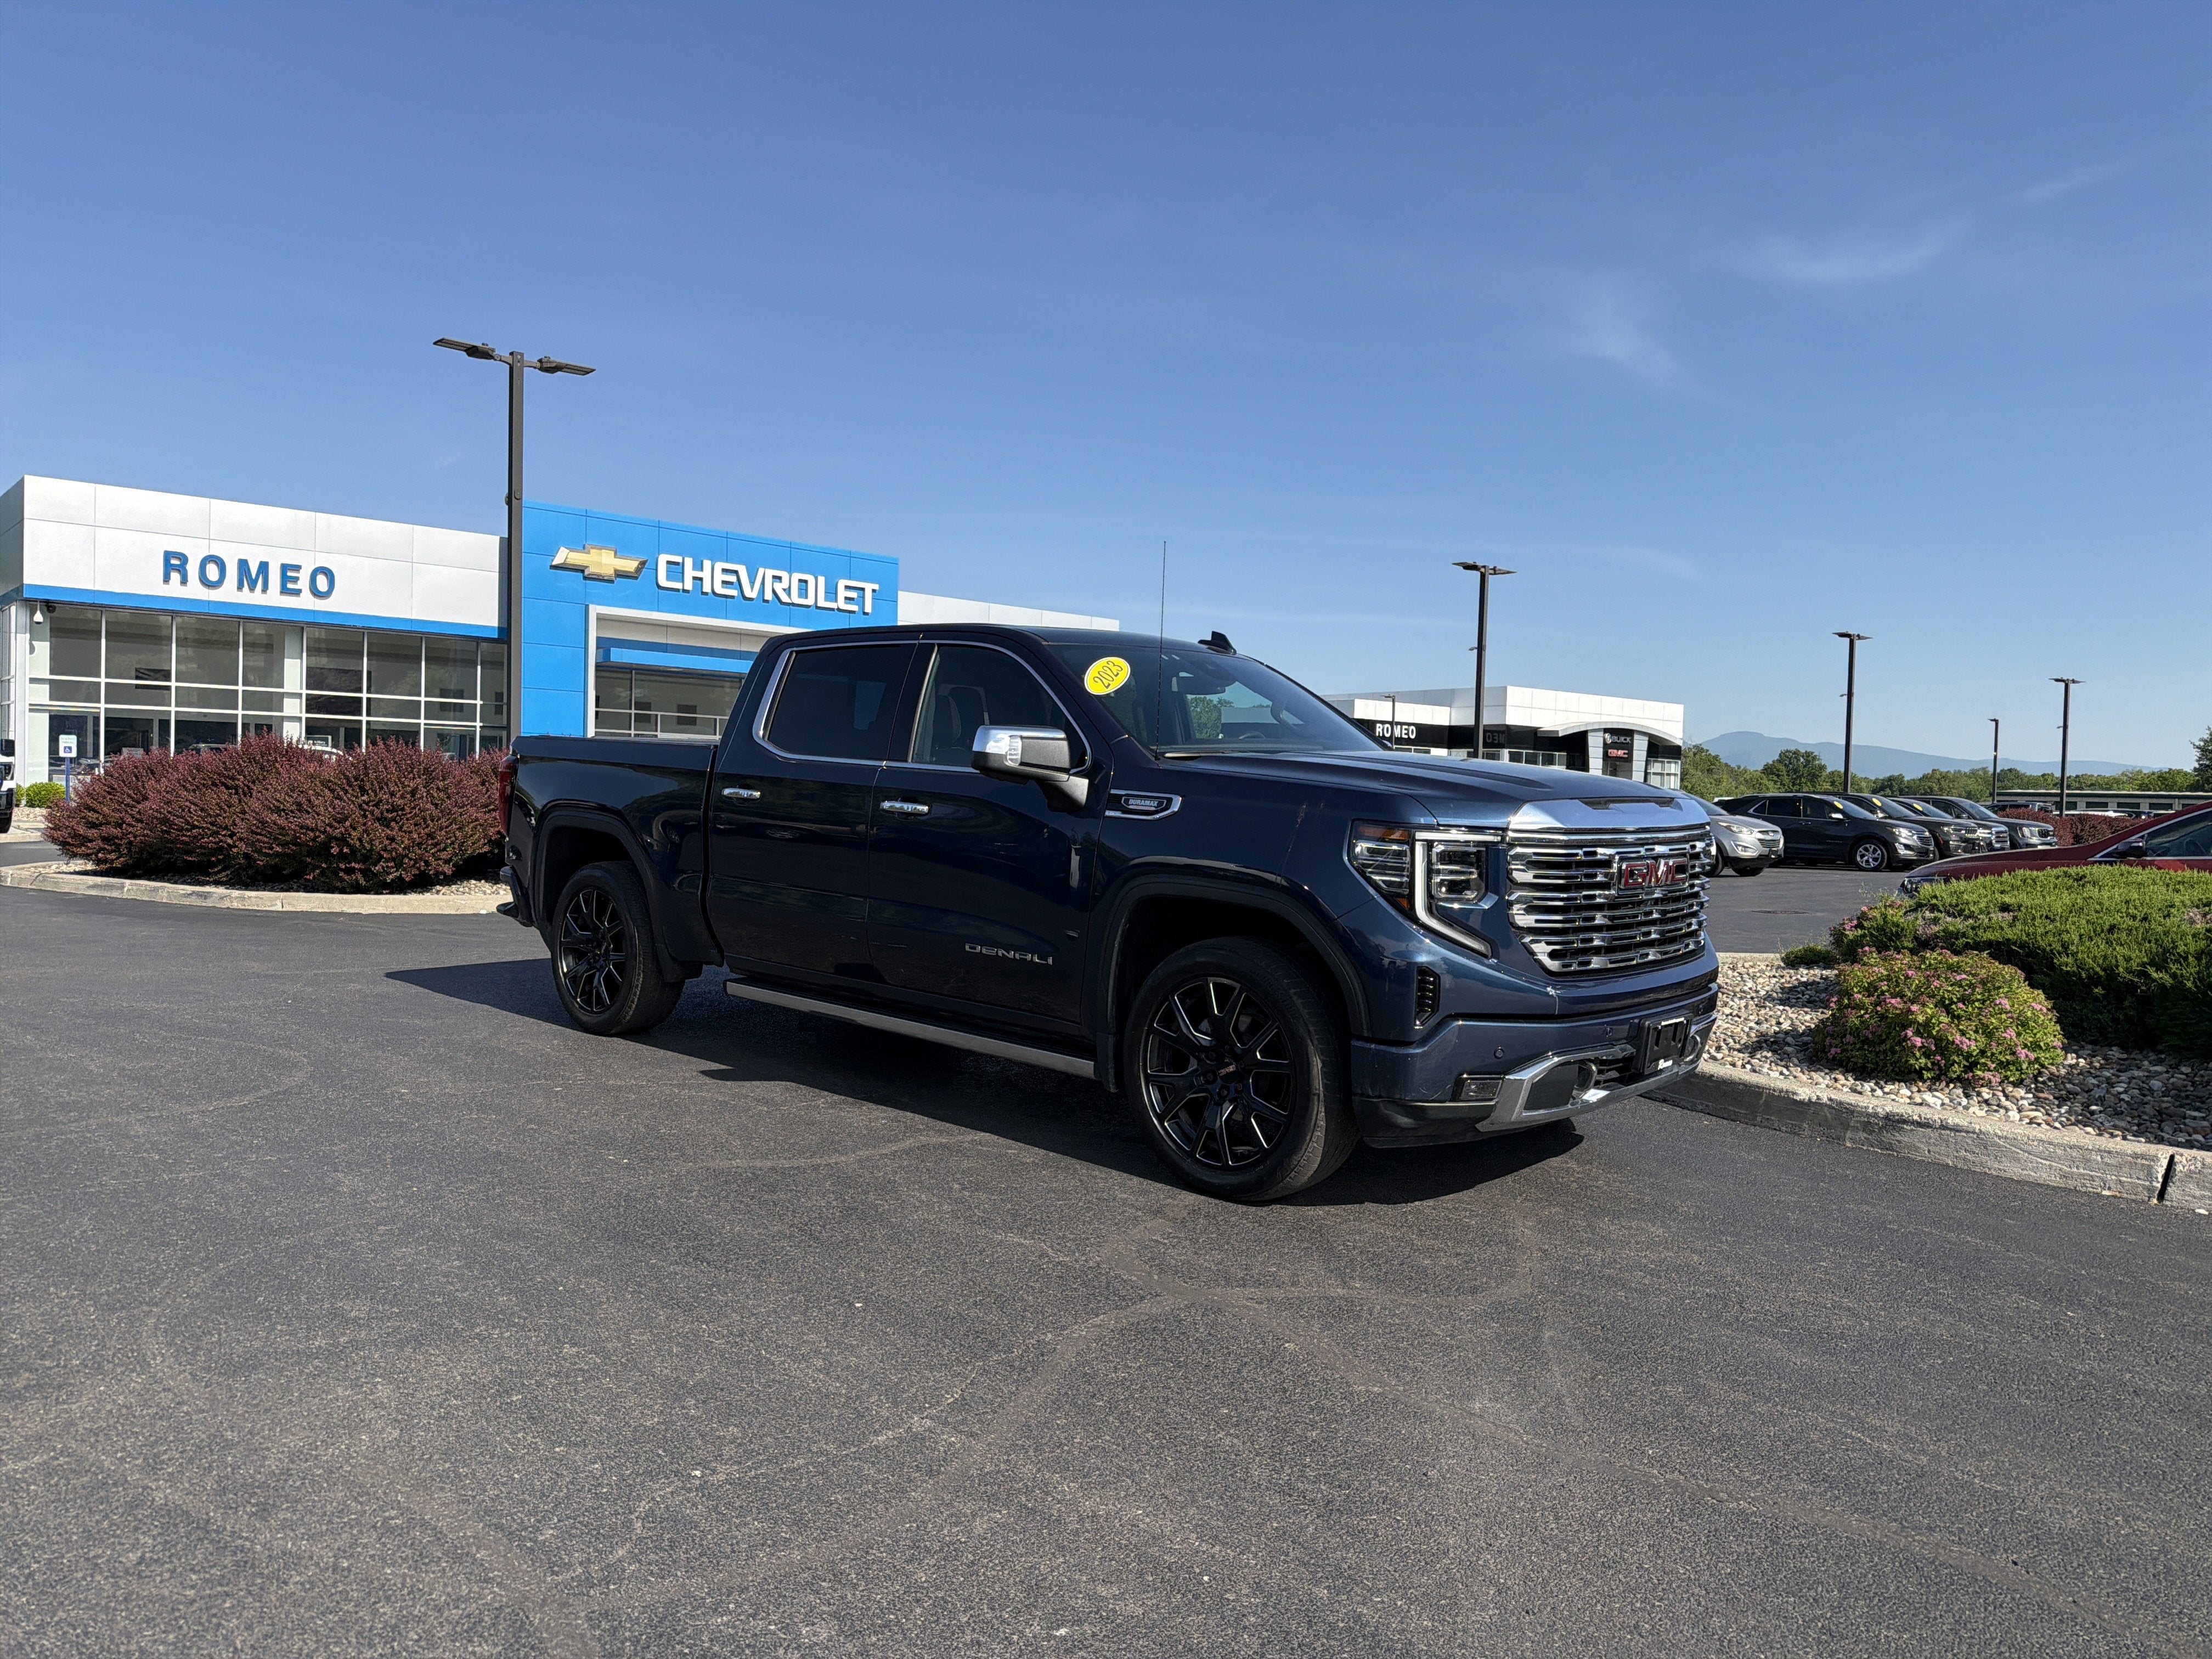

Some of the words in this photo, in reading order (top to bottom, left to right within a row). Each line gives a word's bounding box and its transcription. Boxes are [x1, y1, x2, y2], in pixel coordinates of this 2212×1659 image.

[162, 550, 336, 598] ROMEO
[657, 554, 879, 614] CHEVROLET
[1093, 660, 1123, 689] 2023
[1376, 723, 1416, 739] ROMEO
[1607, 749, 1628, 758] GMC
[1621, 857, 1688, 888] GMC
[964, 943, 1053, 966] DENALI
